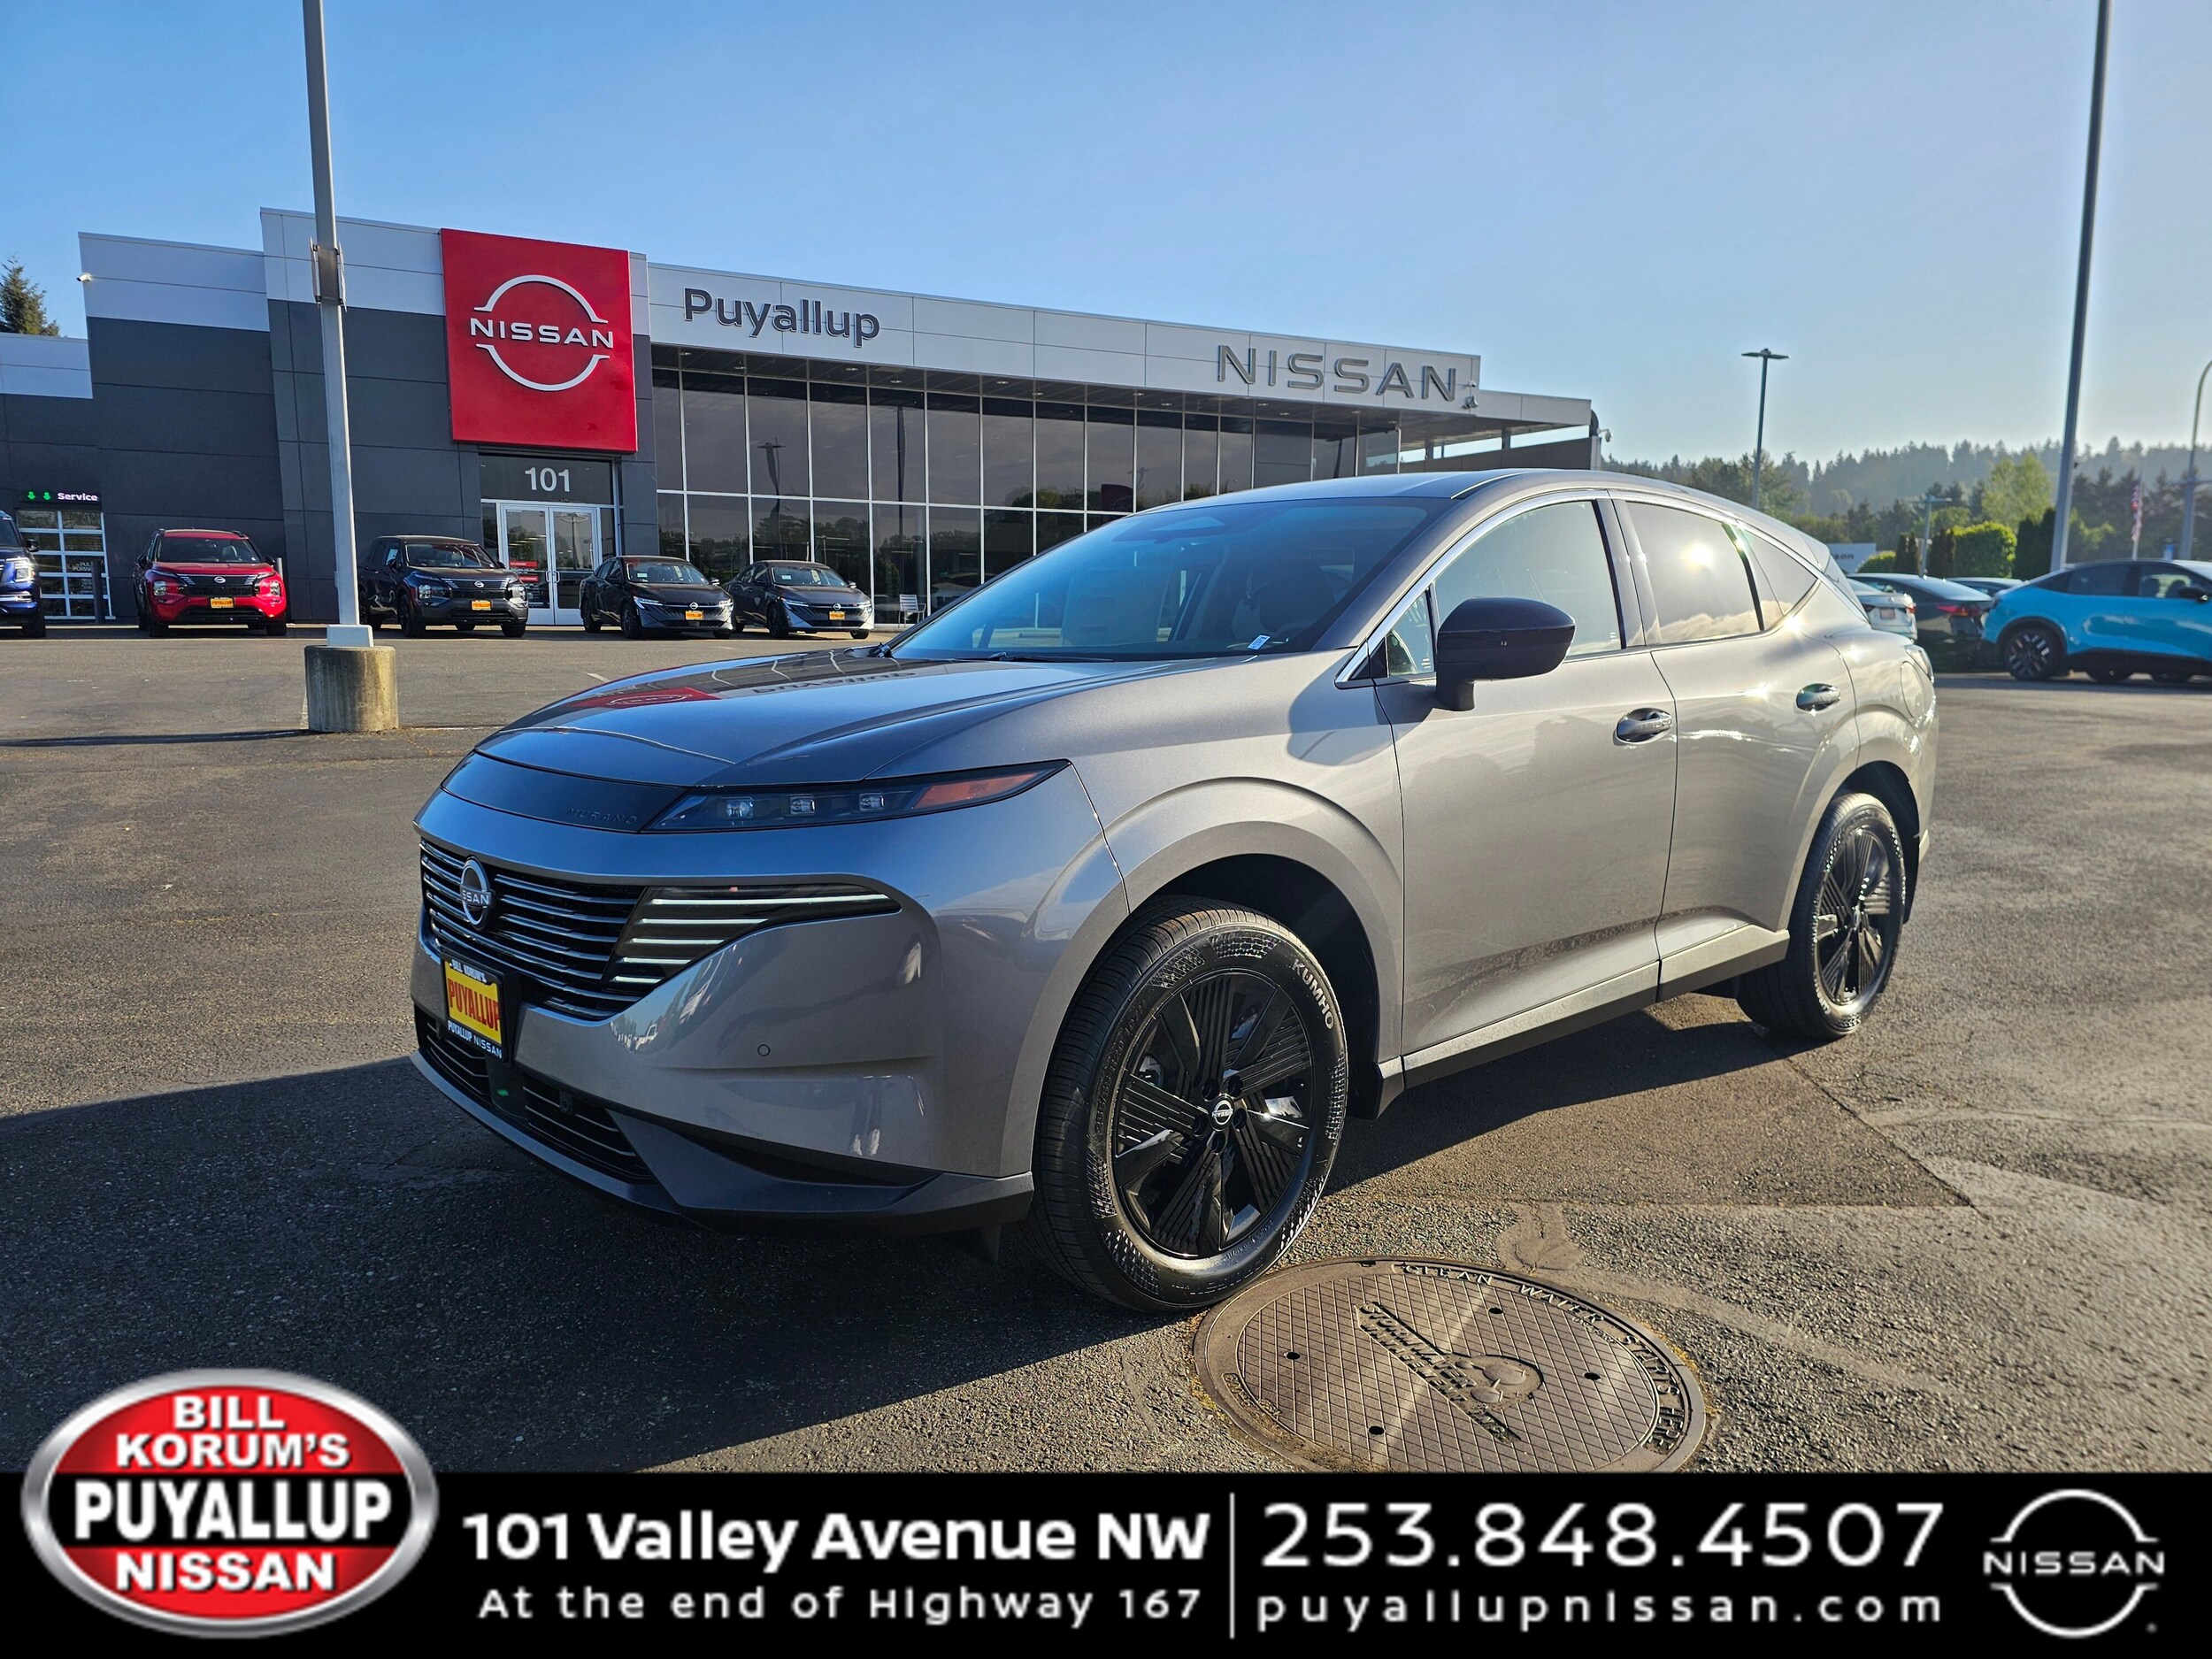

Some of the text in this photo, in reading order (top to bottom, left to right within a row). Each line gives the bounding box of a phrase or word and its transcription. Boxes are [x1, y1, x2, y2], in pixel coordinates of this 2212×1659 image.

[470, 317, 614, 349] NISSAN
[683, 288, 880, 348] Puyallup
[1217, 344, 1457, 402] NISSAN
[57, 492, 99, 502] Service
[525, 467, 571, 493] 101
[566, 807, 637, 825] MURANO
[448, 978, 500, 1033] PUYALLUP
[1292, 958, 1334, 1030] KUMHO
[448, 1019, 503, 1059] PUYALLUP NISSAN
[1403, 1264, 1685, 1451] CLEAN WATER STARTS HERE
